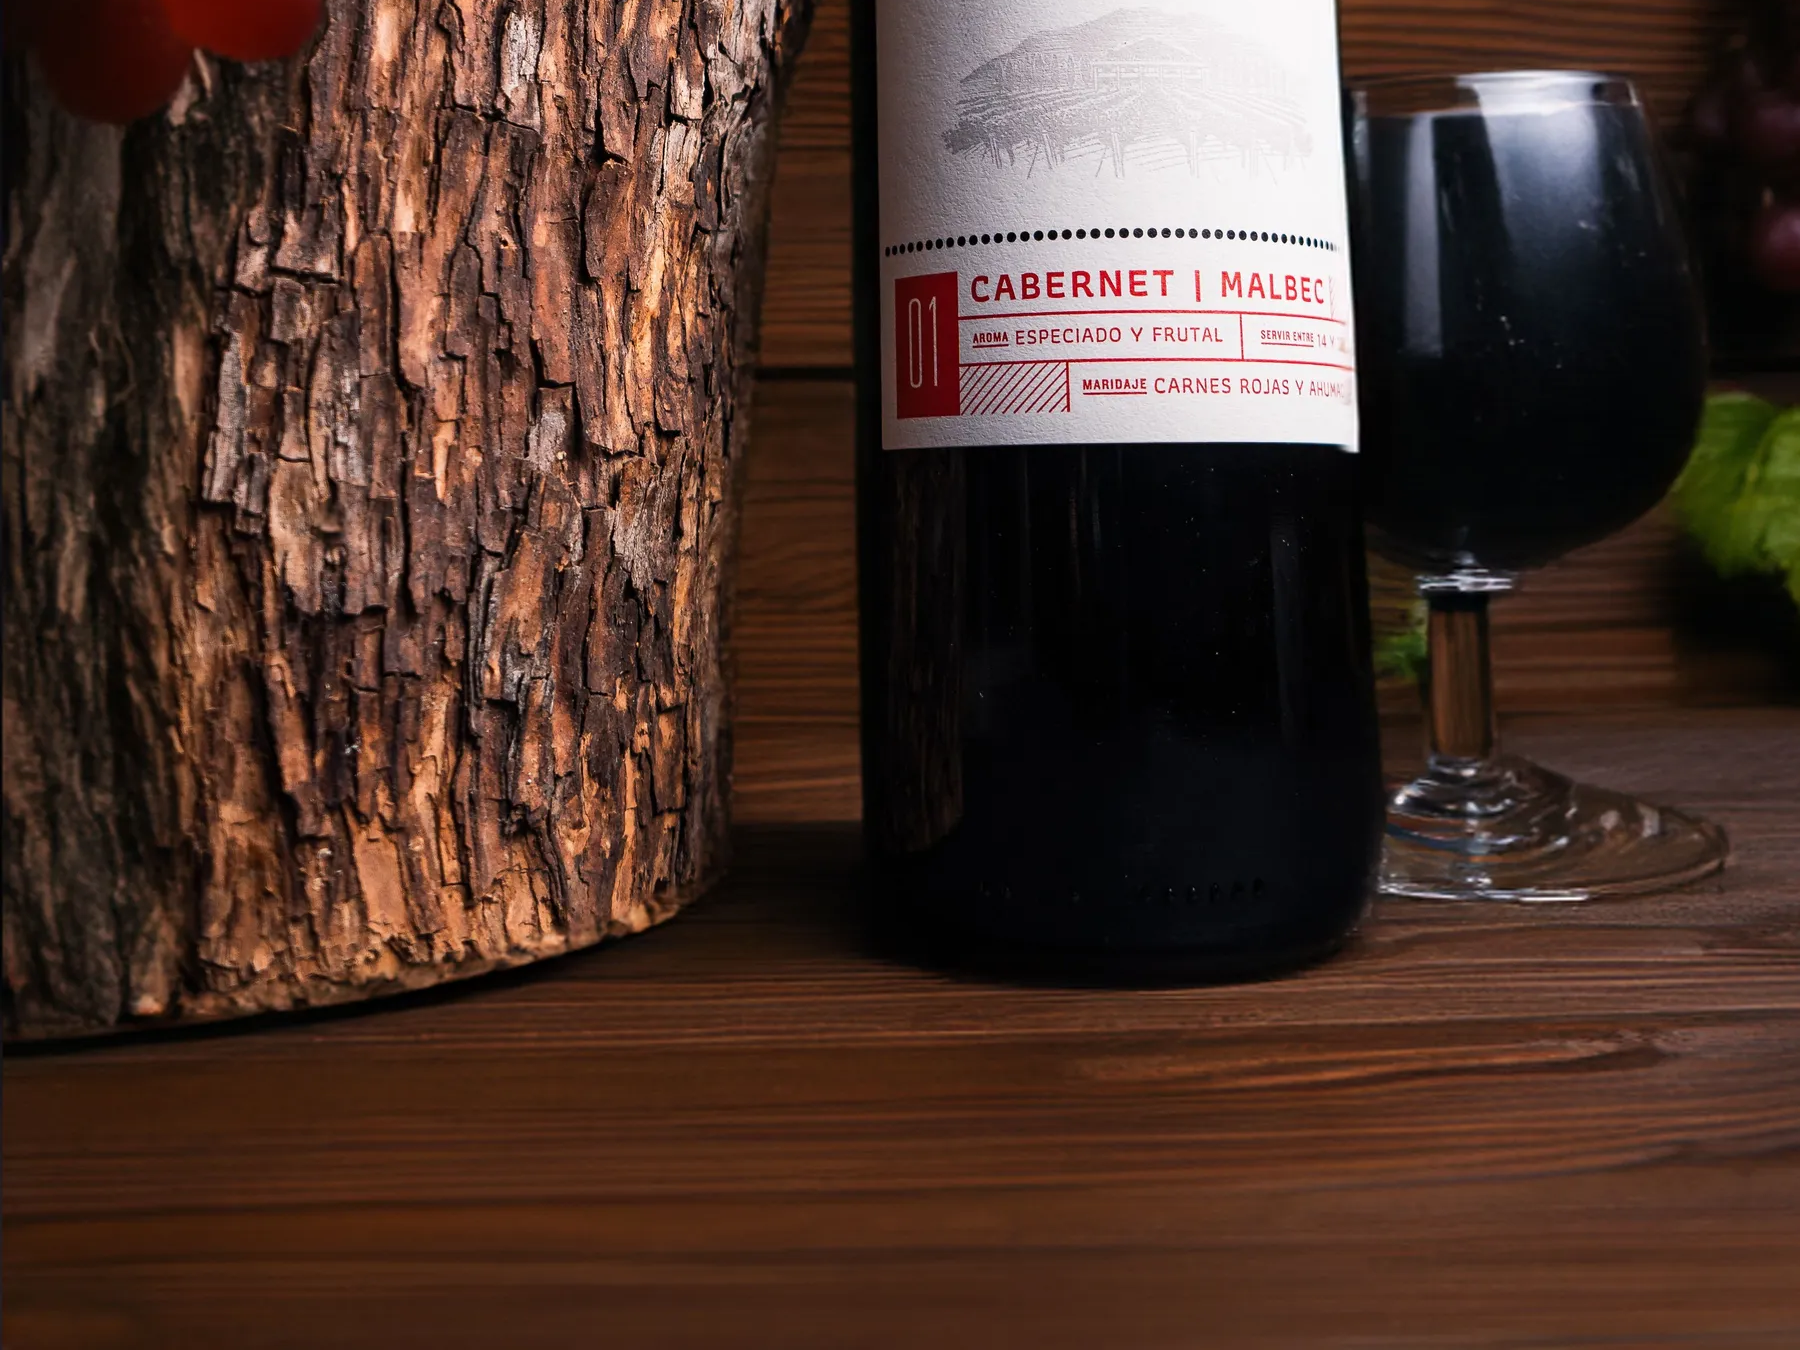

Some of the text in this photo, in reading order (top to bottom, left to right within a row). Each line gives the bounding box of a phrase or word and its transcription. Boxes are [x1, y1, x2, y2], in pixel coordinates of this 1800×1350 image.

[971, 269, 1325, 305] CABERNET MALBEC
[908, 295, 938, 390] 01
[972, 327, 1223, 345] AROMA ESPECIADO Y FRUTAL
[1260, 329, 1291, 341] SERVIR
[1293, 331, 1314, 343] ENTRE
[1083, 378, 1147, 391] MARIDAJE
[1154, 377, 1231, 394] CARNES
[1240, 378, 1290, 395] ROJAS
[1295, 379, 1304, 396] Y
